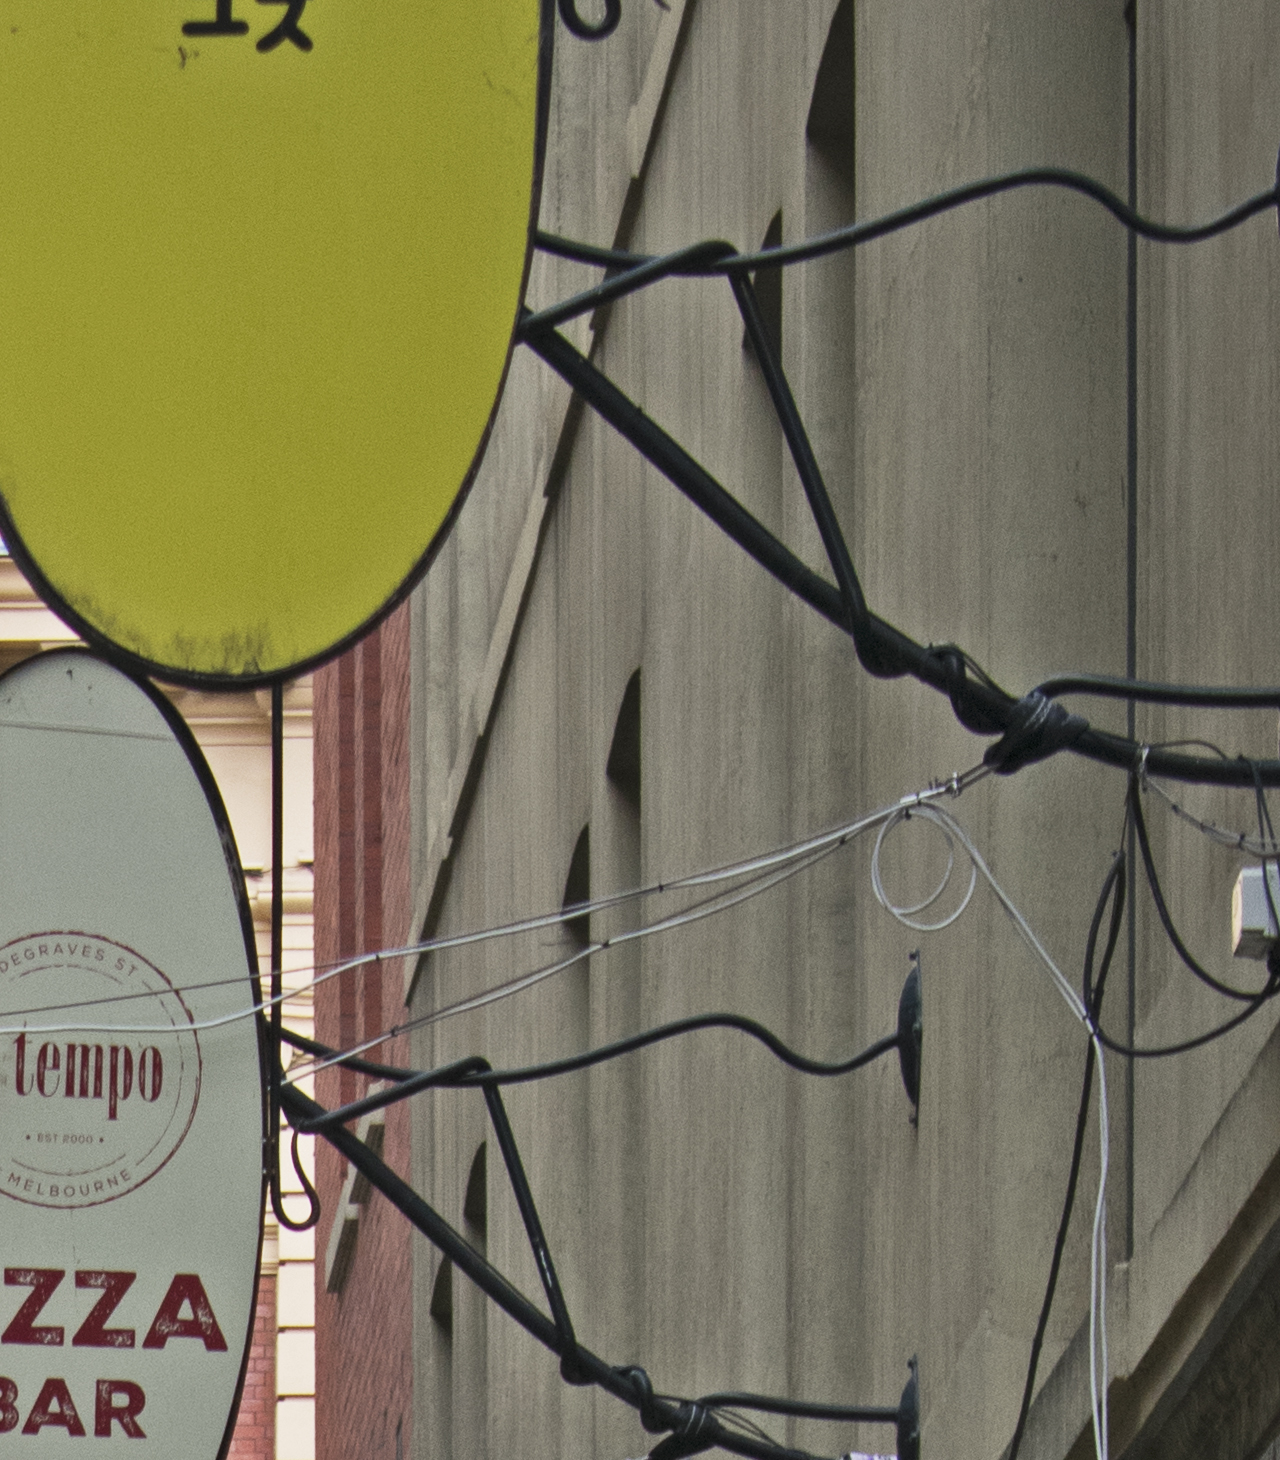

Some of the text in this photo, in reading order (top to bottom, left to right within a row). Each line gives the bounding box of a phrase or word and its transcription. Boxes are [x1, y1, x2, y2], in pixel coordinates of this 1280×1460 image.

[114, 957, 139, 977] ST
[13, 1021, 164, 1121] tempo
[7, 1168, 131, 1198] MELBOURNE
